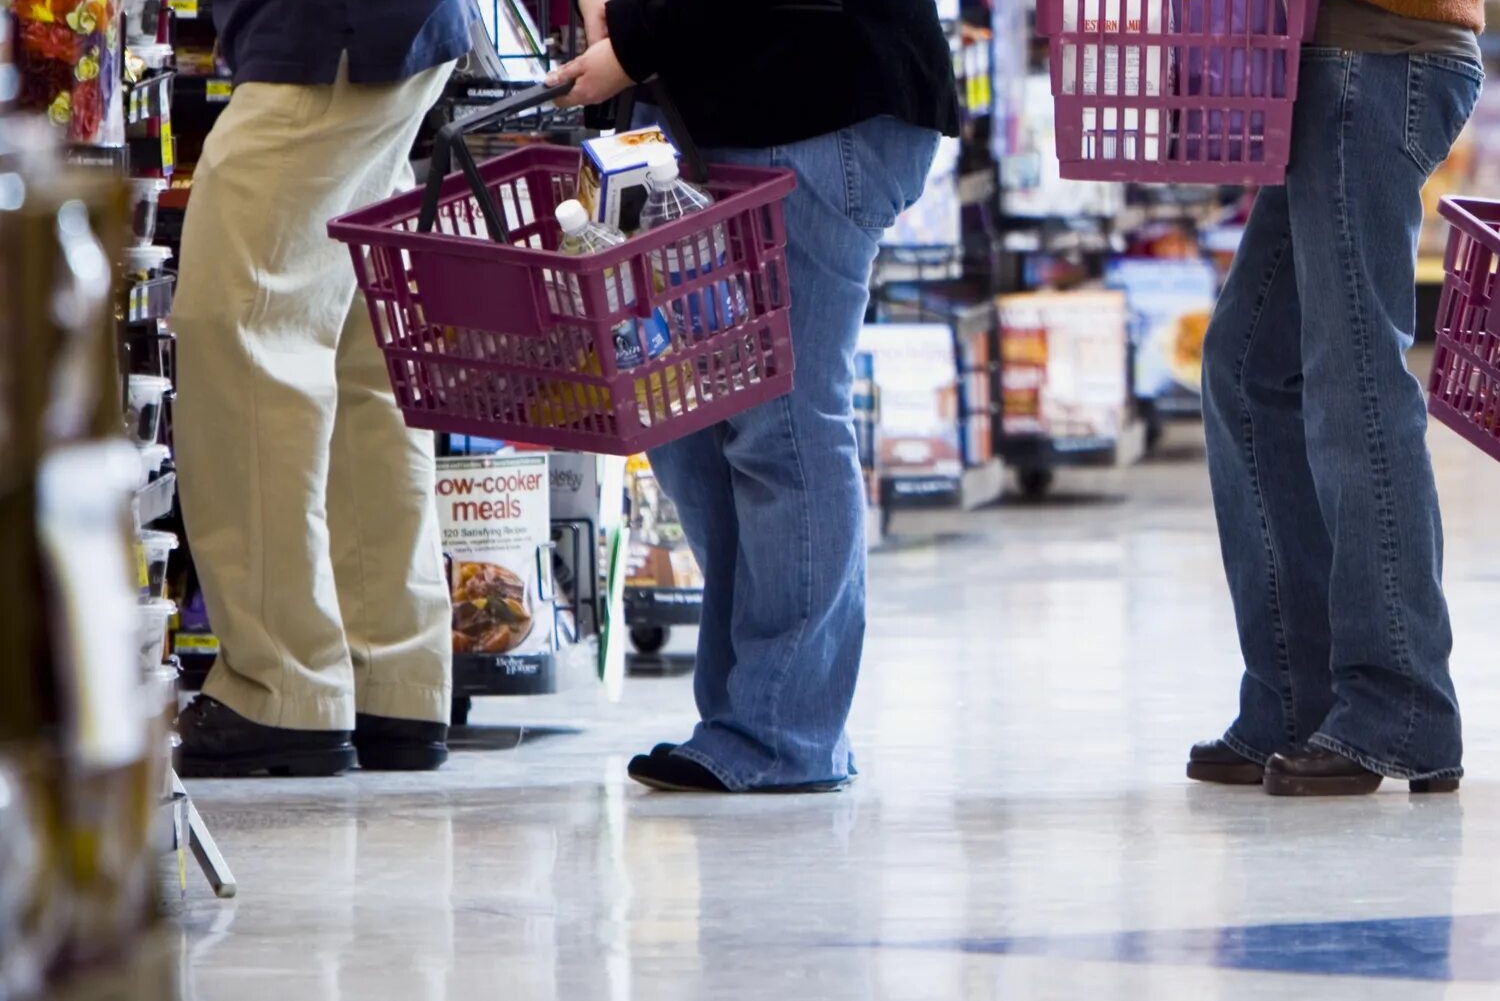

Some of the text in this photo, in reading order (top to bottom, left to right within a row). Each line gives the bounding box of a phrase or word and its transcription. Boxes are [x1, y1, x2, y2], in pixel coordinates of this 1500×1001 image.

[467, 88, 505, 98] GLAMOUR
[435, 470, 543, 496] ow-cooker
[452, 494, 522, 522] meals
[443, 528, 458, 538] 120
